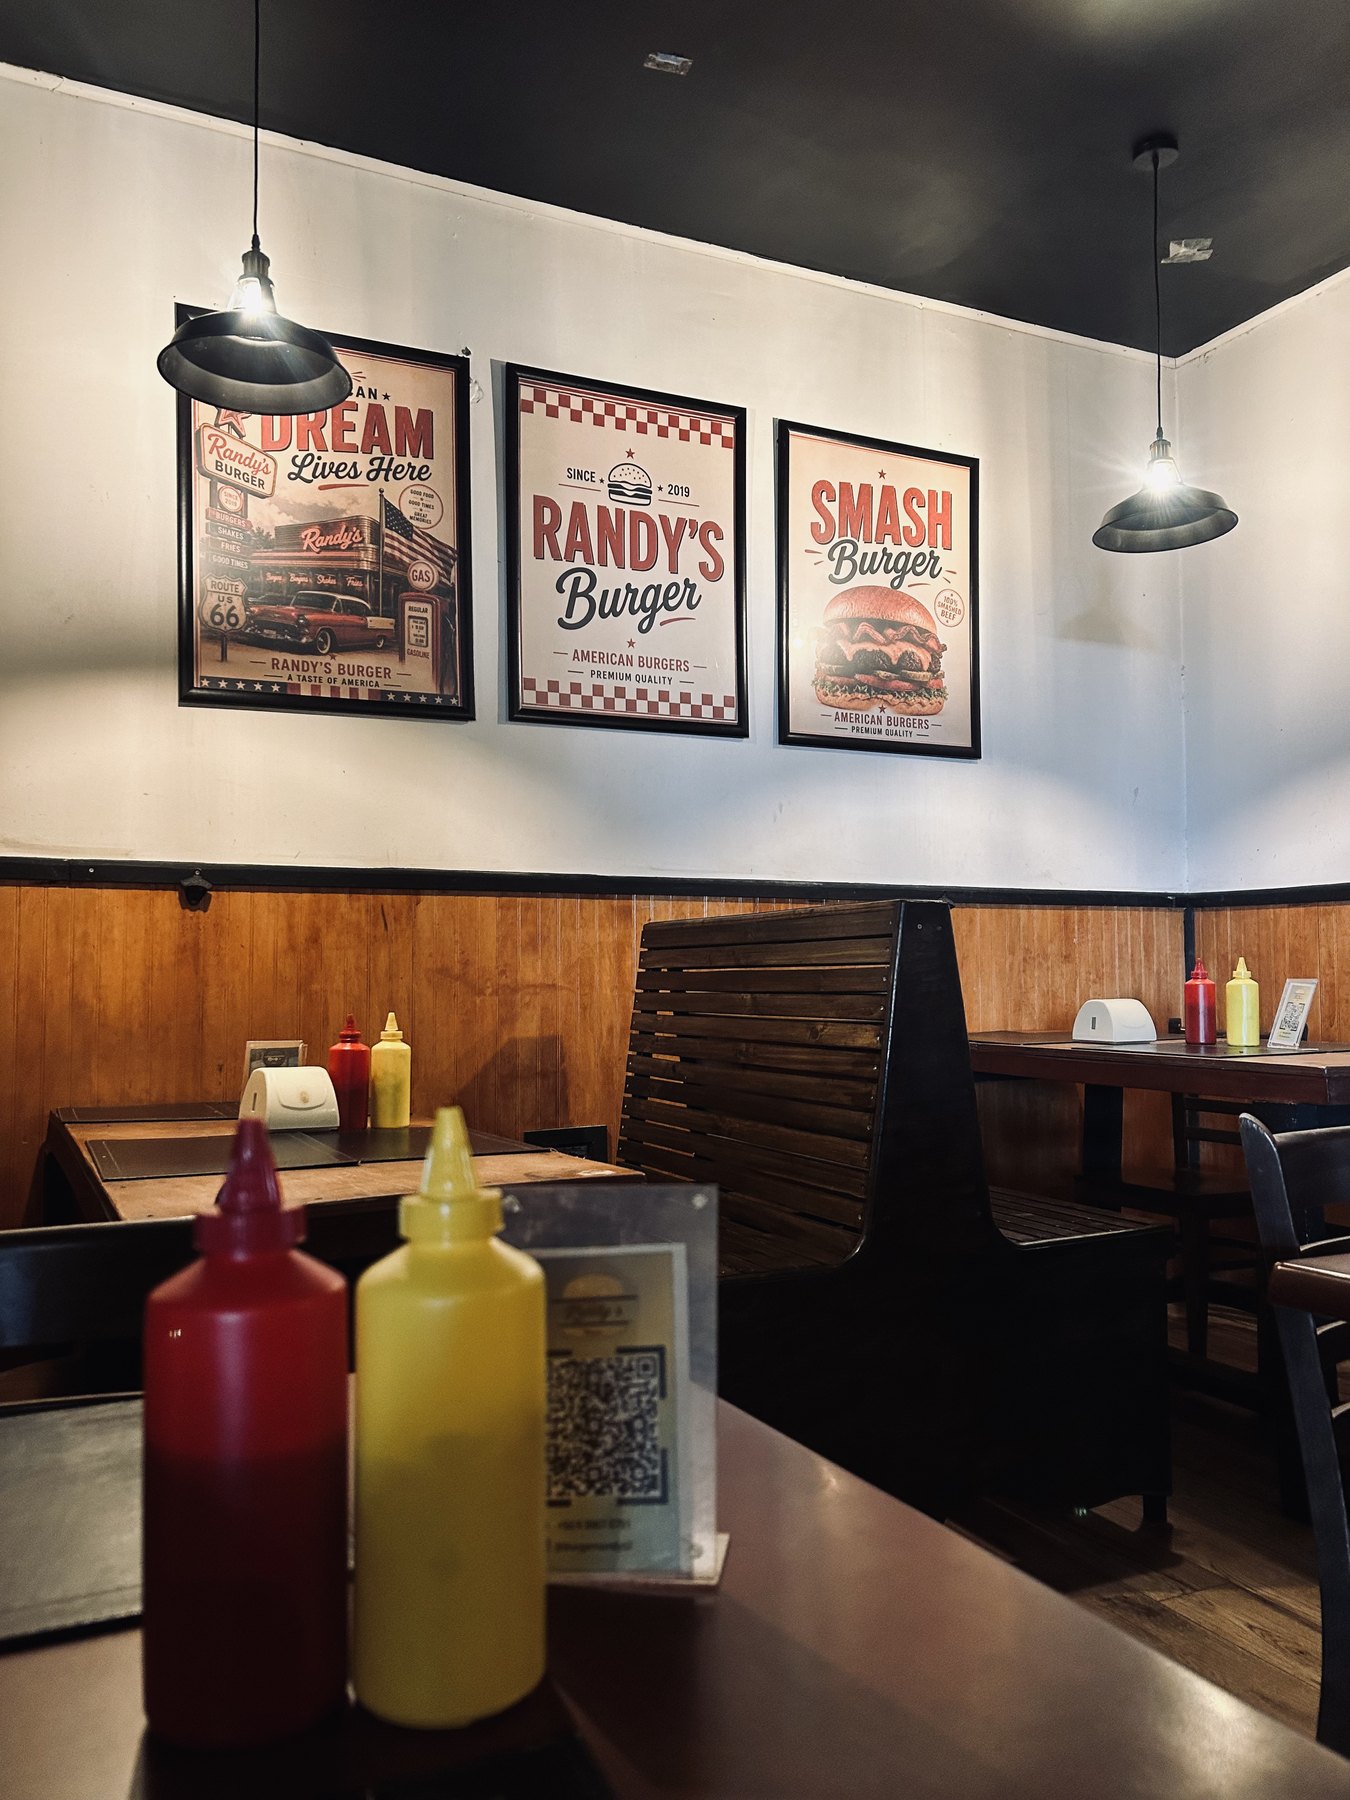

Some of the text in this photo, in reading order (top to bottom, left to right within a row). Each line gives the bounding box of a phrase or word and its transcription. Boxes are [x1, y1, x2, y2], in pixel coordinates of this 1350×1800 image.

[261, 400, 434, 460] DREAM
[207, 433, 272, 476] Randy's
[215, 459, 265, 490] BURGER
[287, 452, 432, 483] Lives Here
[566, 467, 690, 498] SINCE 2019
[215, 511, 246, 528] BURGERS
[810, 479, 953, 550] SMASH
[217, 526, 244, 540] SHAKES
[301, 524, 363, 553] Randy's
[532, 494, 725, 583] RANDY'S
[220, 541, 241, 553] FRIES
[212, 554, 249, 569] GOOD TIMES
[827, 538, 943, 590] Burger
[411, 569, 431, 582] GAS
[210, 580, 240, 593] ROUTE
[408, 605, 428, 614] REGULAR
[555, 566, 702, 634] Burger
[937, 601, 962, 615] SMASHED
[210, 603, 239, 628] 66
[941, 609, 956, 621] BEEF
[407, 648, 430, 659] GASOLINE
[572, 648, 690, 673] AMERICAN BURGERS
[271, 657, 392, 679] RANDY'S BURGER
[590, 669, 673, 686] PREMIUM QUALITY
[287, 673, 380, 688] A TASTE OF AMERICA
[834, 711, 930, 730] AMERICAN BURGERS
[851, 726, 913, 738] PREMIUM QUALITY
